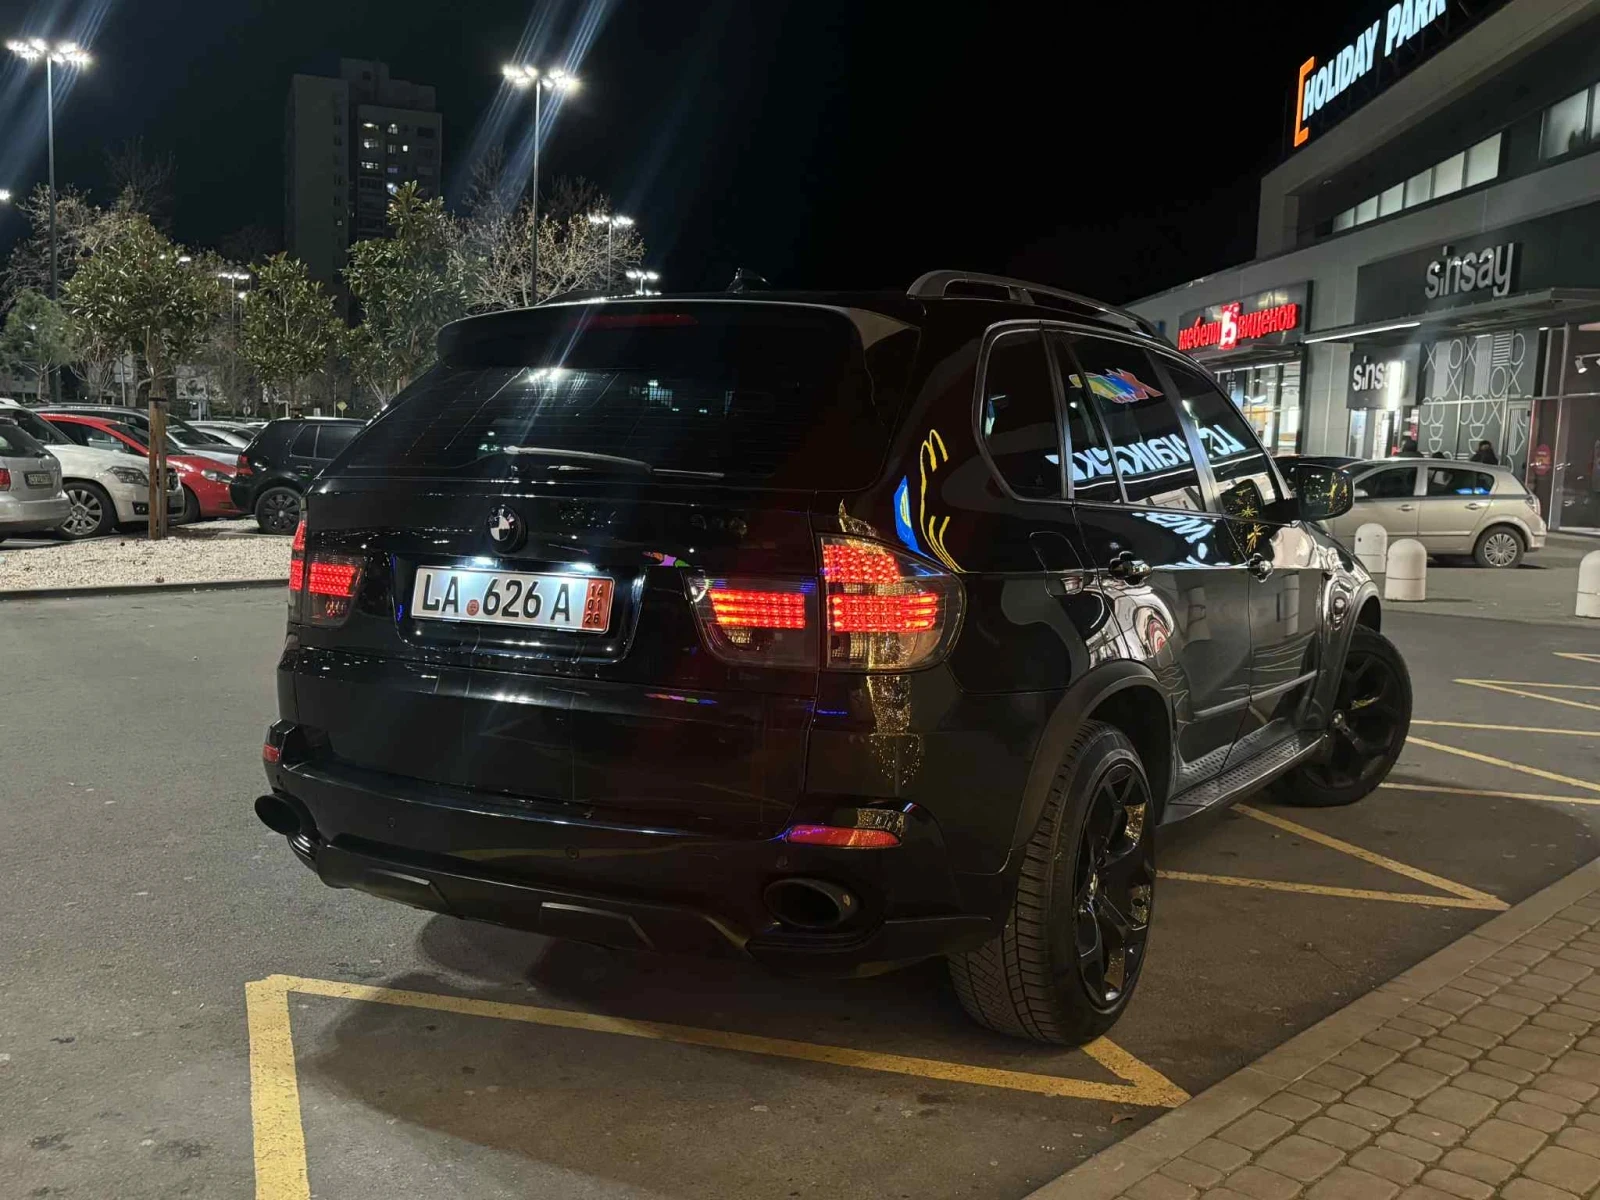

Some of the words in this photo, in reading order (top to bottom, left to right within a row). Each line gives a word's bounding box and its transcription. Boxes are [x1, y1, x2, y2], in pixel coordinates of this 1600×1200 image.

[1302, 19, 1380, 121] HOLIDAY
[1425, 243, 1514, 299] sinsay
[1178, 316, 1221, 350] мебели
[1237, 303, 1298, 340] виденов
[1352, 355, 1405, 396] sins
[422, 574, 459, 613] LA
[482, 578, 542, 618] 626
[549, 583, 571, 621] A
[585, 611, 600, 624] 26
[587, 598, 602, 611] 01
